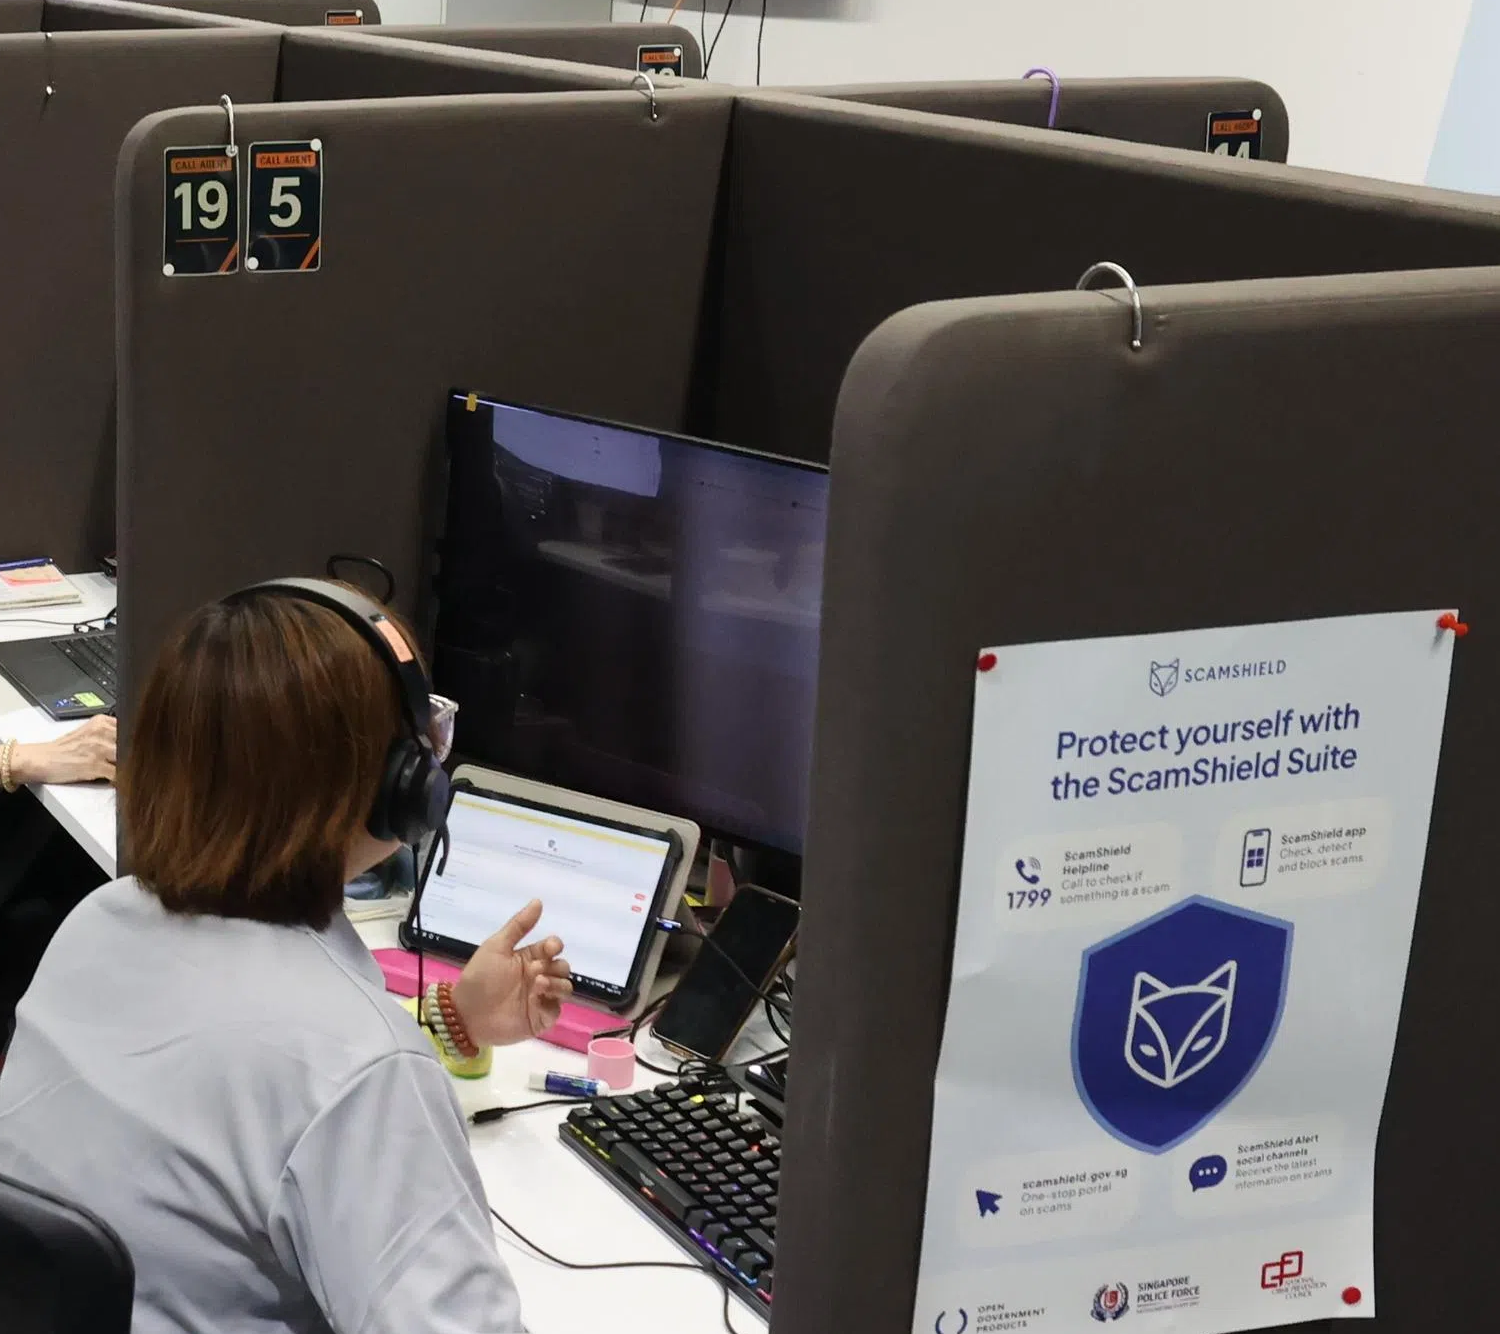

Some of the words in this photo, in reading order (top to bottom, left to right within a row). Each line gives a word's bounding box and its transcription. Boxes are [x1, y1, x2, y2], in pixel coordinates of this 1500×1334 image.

[175, 161, 198, 170] CALL
[200, 159, 229, 170] AGENT
[259, 156, 280, 165] CALL
[284, 154, 312, 165] AGENT
[174, 180, 228, 230] 19
[269, 176, 302, 228] 5
[1184, 659, 1288, 683] SCAMSHIELD
[1056, 724, 1170, 760] Protect
[1174, 708, 1295, 756] yourself
[1299, 703, 1361, 734] with
[1050, 771, 1100, 801] the
[1107, 750, 1281, 795] ScamShield
[1287, 744, 1358, 775] Suite
[1281, 827, 1343, 845] ScamShield
[1345, 826, 1367, 841] app
[1064, 843, 1132, 862] ScamShield
[1318, 841, 1353, 855] detect
[1062, 862, 1111, 876] Helpline
[1277, 861, 1297, 873] and
[1300, 858, 1328, 871] block
[1061, 878, 1083, 891] Call
[1085, 876, 1097, 888] to
[1099, 872, 1133, 886] check
[1135, 870, 1143, 882] if
[1006, 888, 1052, 910] 1799
[1060, 888, 1119, 905] something
[1120, 888, 1129, 897] is
[1131, 886, 1139, 896] a
[1141, 882, 1171, 895] scam
[1237, 1137, 1294, 1154] ScamShield
[1295, 1134, 1319, 1145] Alert
[1236, 1154, 1265, 1166] social
[1266, 1147, 1308, 1161] channels
[1290, 1171, 1302, 1181] on
[1021, 1188, 1077, 1203] One-stop
[1078, 1182, 1112, 1197] portal
[1019, 1207, 1035, 1216] on
[1036, 1203, 1072, 1215] scams
[1137, 1275, 1191, 1292] SINGAPORE
[1136, 1289, 1168, 1303] POLICE
[1171, 1285, 1201, 1299] FORCE
[976, 1308, 1047, 1323] GOVERNMENT
[977, 1303, 1005, 1314] OPEN
[976, 1320, 1028, 1334] PRODUCTS
